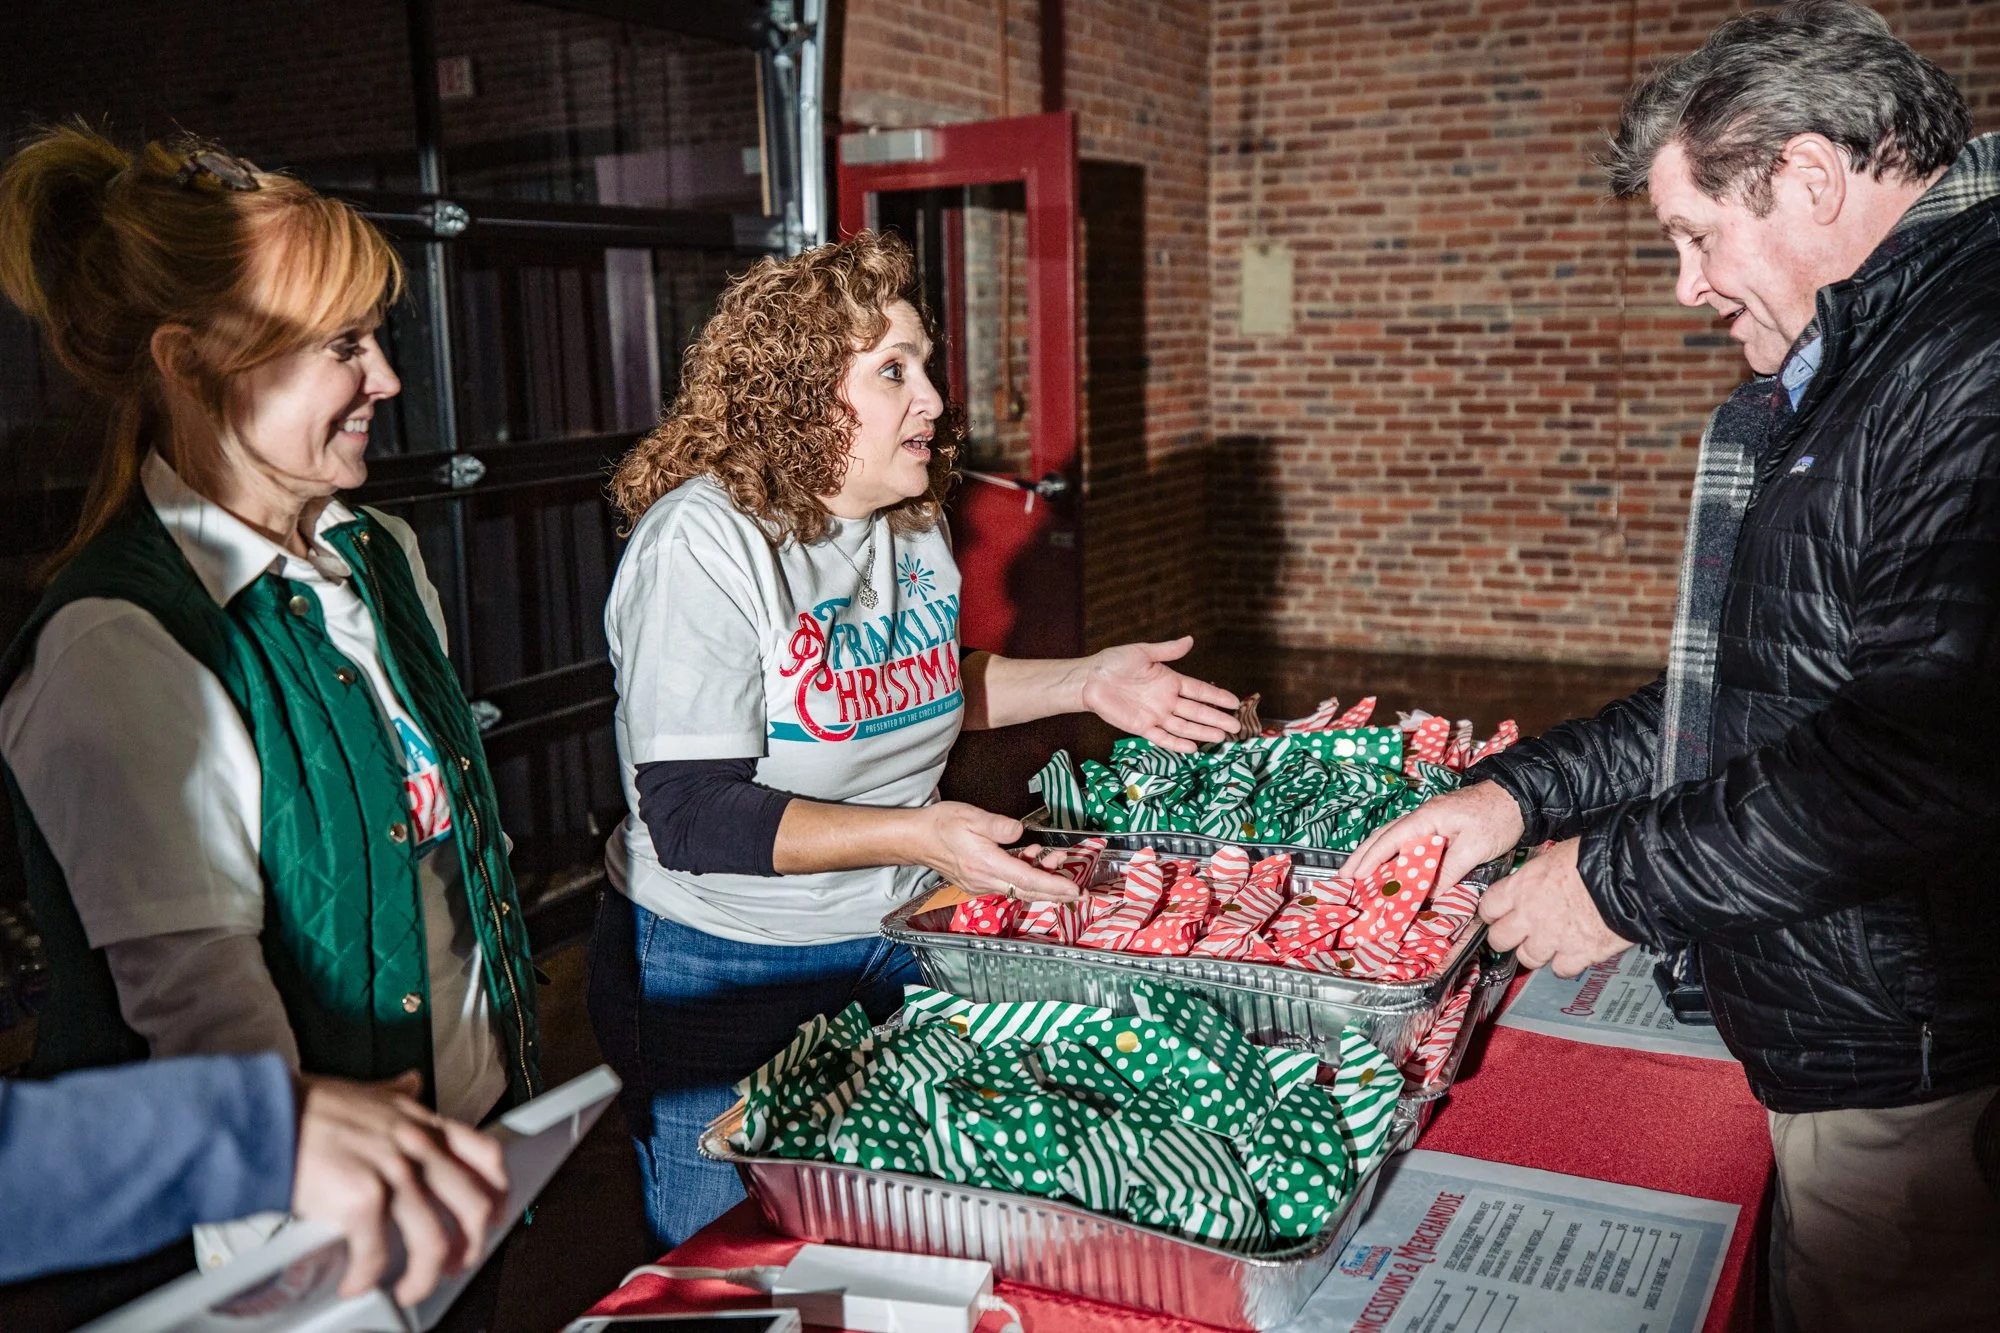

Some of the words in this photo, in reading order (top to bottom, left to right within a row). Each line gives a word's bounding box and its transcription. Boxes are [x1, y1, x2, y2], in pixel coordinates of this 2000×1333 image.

[813, 595, 959, 670] FRANKLIN
[795, 643, 963, 742] CHRISTMA
[865, 718, 898, 733] PRESENTED
[899, 717, 906, 725] BY
[907, 712, 918, 722] THE
[919, 706, 937, 719] CIRCLE
[1560, 978, 1608, 1017] CONCESSIONS
[1393, 1191, 1465, 1265] MERCHANDISE
[1394, 1261, 1421, 1275] &
[1350, 1271, 1415, 1333] NCESSIONS
